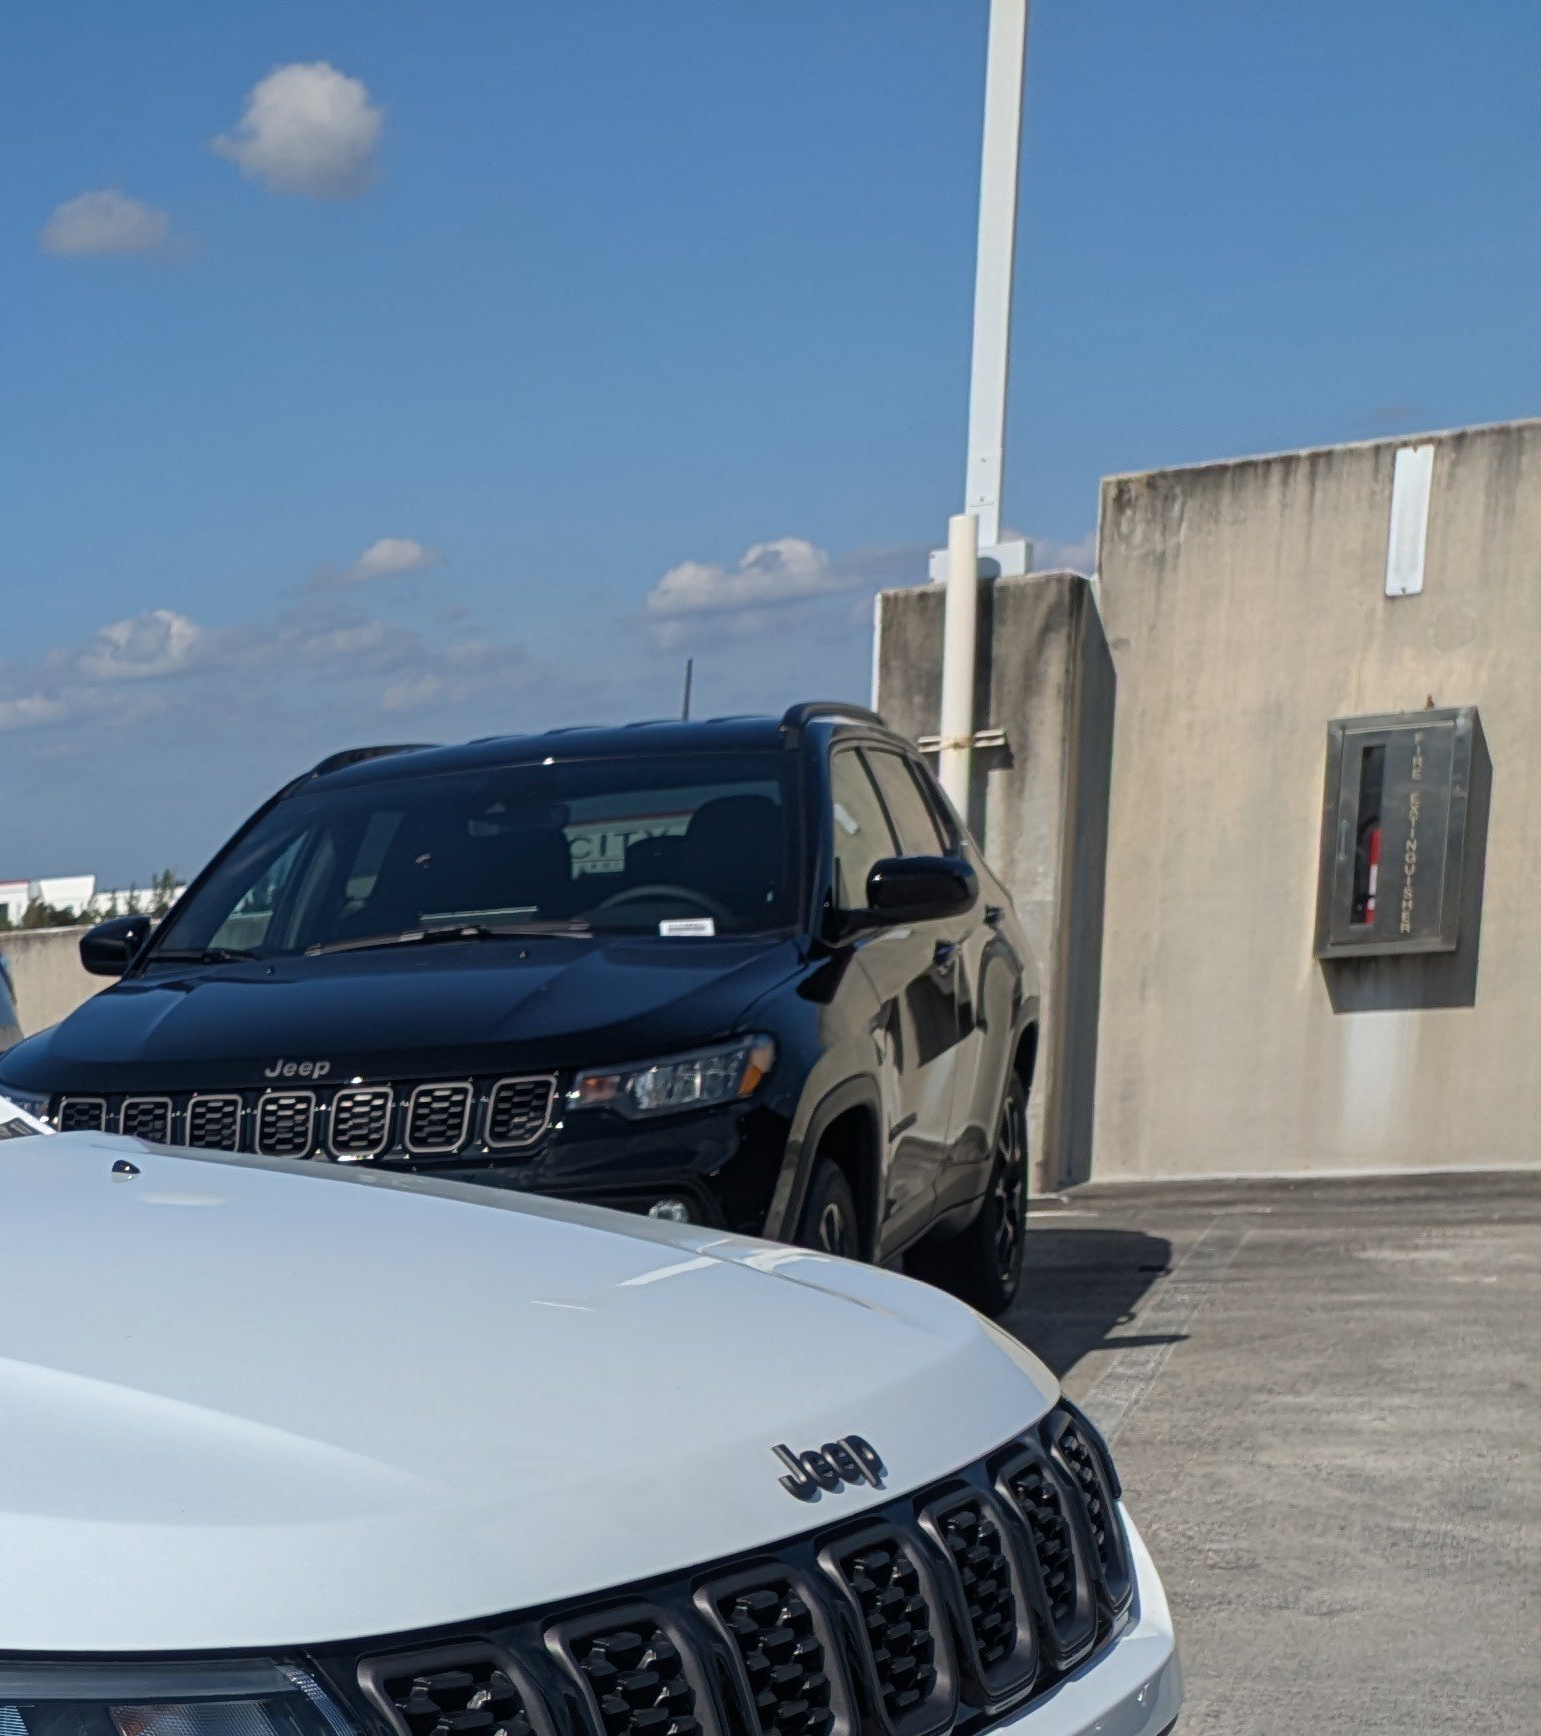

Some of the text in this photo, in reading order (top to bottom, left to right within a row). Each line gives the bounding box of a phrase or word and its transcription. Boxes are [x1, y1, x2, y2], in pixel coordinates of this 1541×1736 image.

[1412, 732, 1423, 780] FIRE
[263, 1059, 331, 1079] Jeep
[771, 1435, 884, 1502] Jeep
